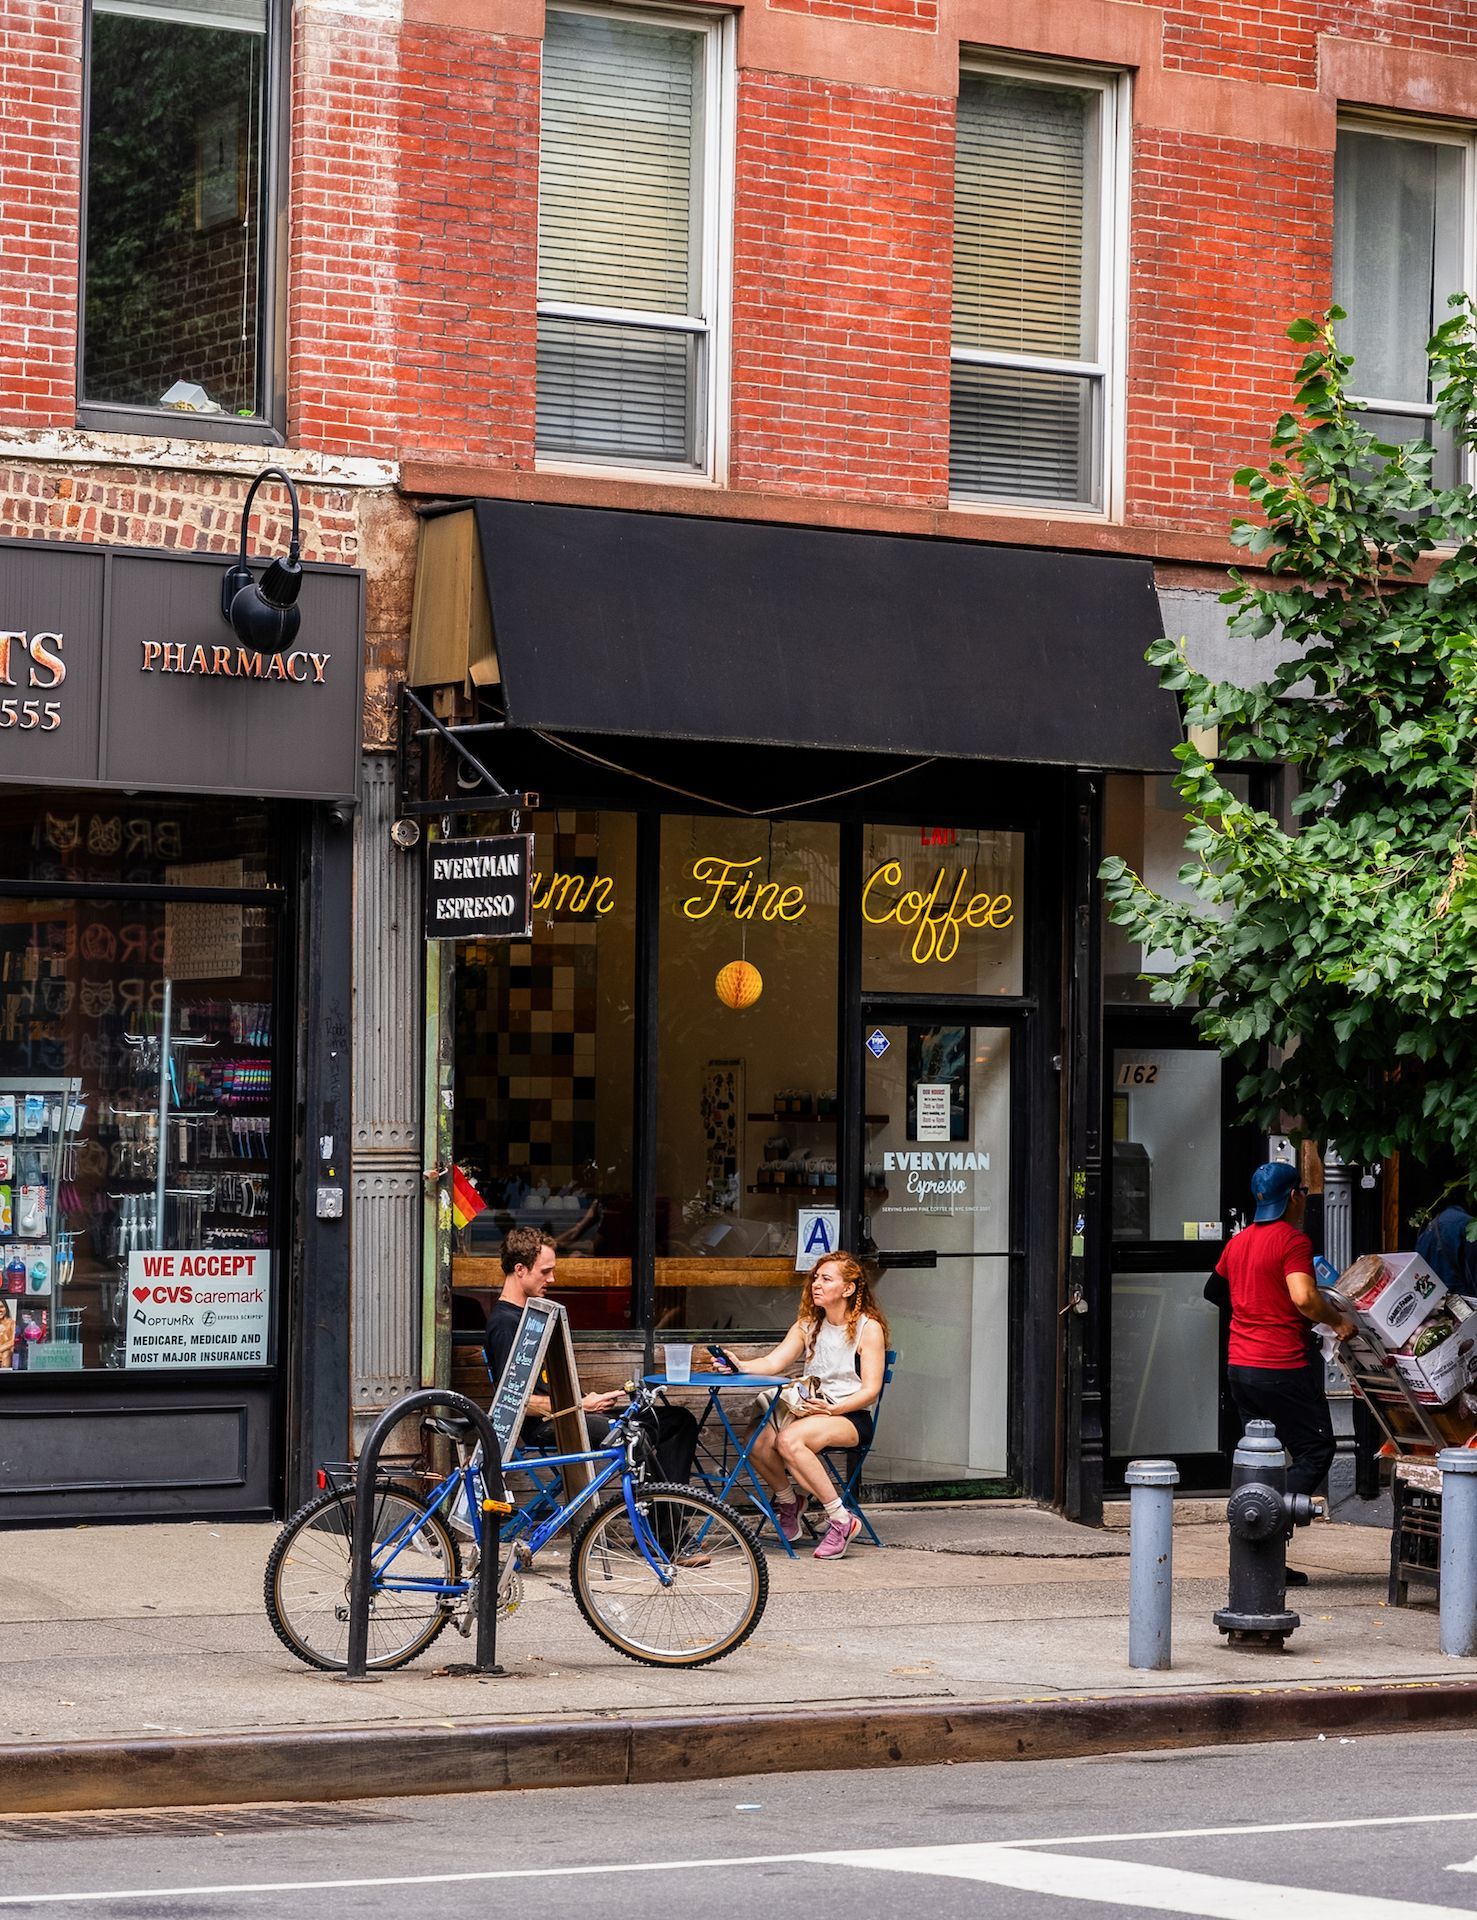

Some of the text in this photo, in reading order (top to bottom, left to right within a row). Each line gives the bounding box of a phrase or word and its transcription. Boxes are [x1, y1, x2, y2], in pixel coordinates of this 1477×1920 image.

[141, 640, 332, 684] PHARMACY
[433, 853, 520, 880] EVERYMAN
[436, 894, 515, 920] ESPRESSO
[683, 856, 807, 922] Fine
[861, 859, 1015, 965] Coffee
[1122, 1064, 1158, 1084] 162
[883, 1151, 991, 1171] EVERYMAN
[906, 1171, 968, 1203] Espresso
[805, 1217, 831, 1254] A
[143, 1255, 257, 1277] WE ACCEPT
[152, 1286, 264, 1304] CVS caremark
[133, 1333, 261, 1347] MEDICARE, MEDICAID AND
[131, 1350, 262, 1363] MOST MAJOR INSURANCES
